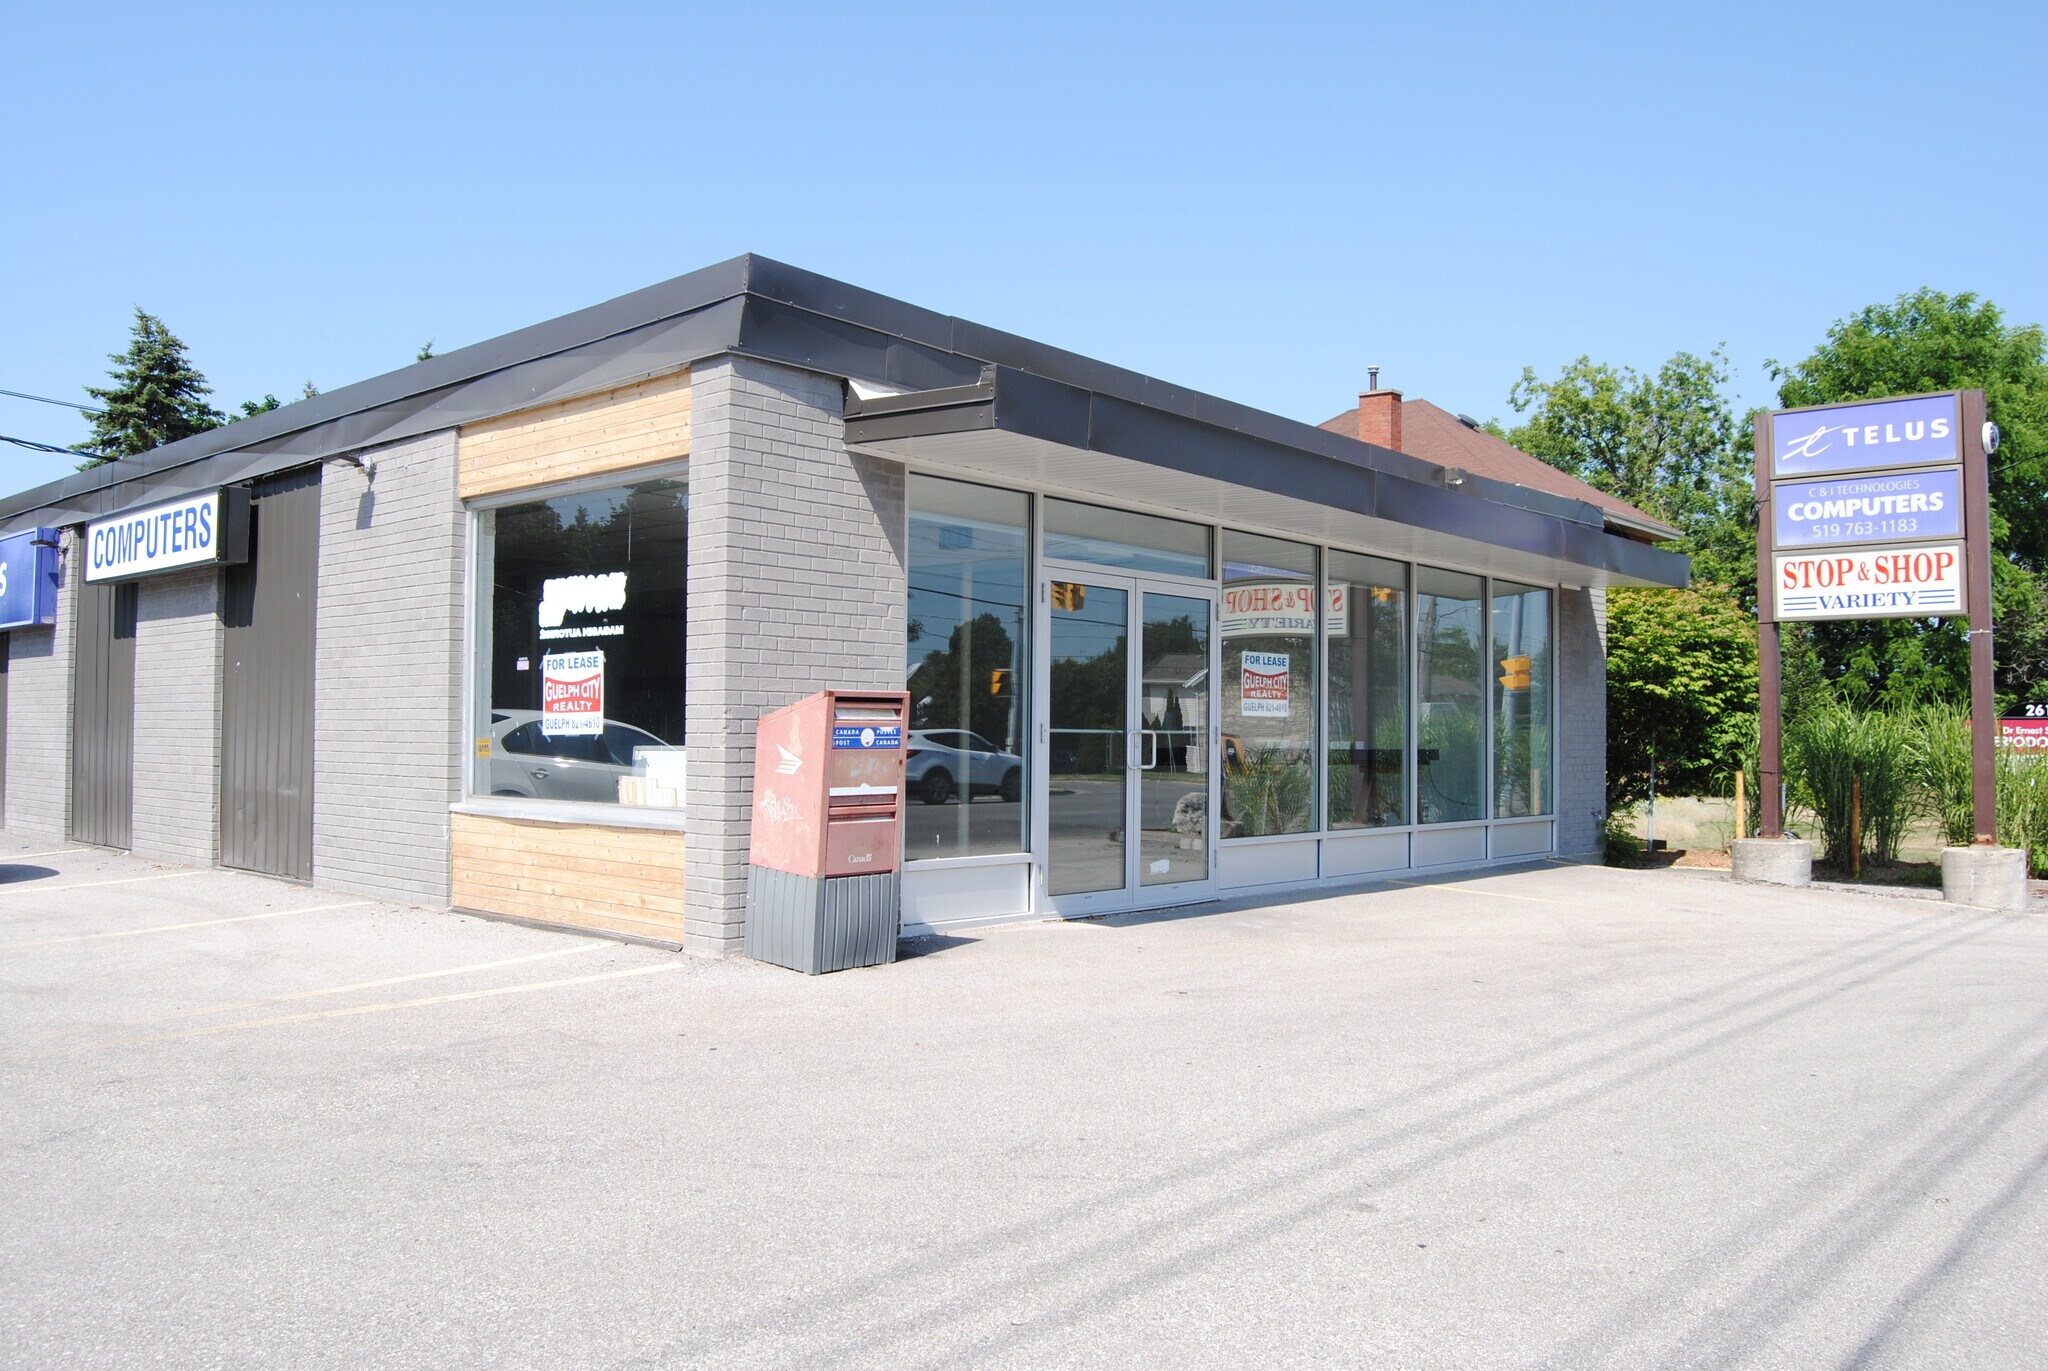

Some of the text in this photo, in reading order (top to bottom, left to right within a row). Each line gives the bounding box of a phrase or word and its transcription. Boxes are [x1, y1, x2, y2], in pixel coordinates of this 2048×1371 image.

[1842, 418, 1949, 447] TELUS
[1808, 479, 1920, 497] C & I TECHNOLOGIES
[1787, 491, 1944, 522] COMPUTERS
[94, 502, 212, 569] COMPUTERS
[1812, 518, 1917, 538] 519 763-1183
[1783, 552, 1954, 590] STOP & SHOP
[1818, 591, 1917, 610] VARIETY
[547, 656, 599, 671] FOR LEASE
[1245, 655, 1287, 667] FOR LEASE
[545, 677, 601, 702] GUELPH CITY
[1243, 672, 1288, 690] GUELPH CITY
[1250, 690, 1282, 699] REALTY
[553, 700, 592, 712] REALTY
[1243, 702, 1265, 712] GUELPH
[545, 718, 570, 730] GUELPH
[2002, 726, 2014, 734] Dr
[2016, 726, 2043, 734] Ernest
[848, 853, 872, 863] Canada
